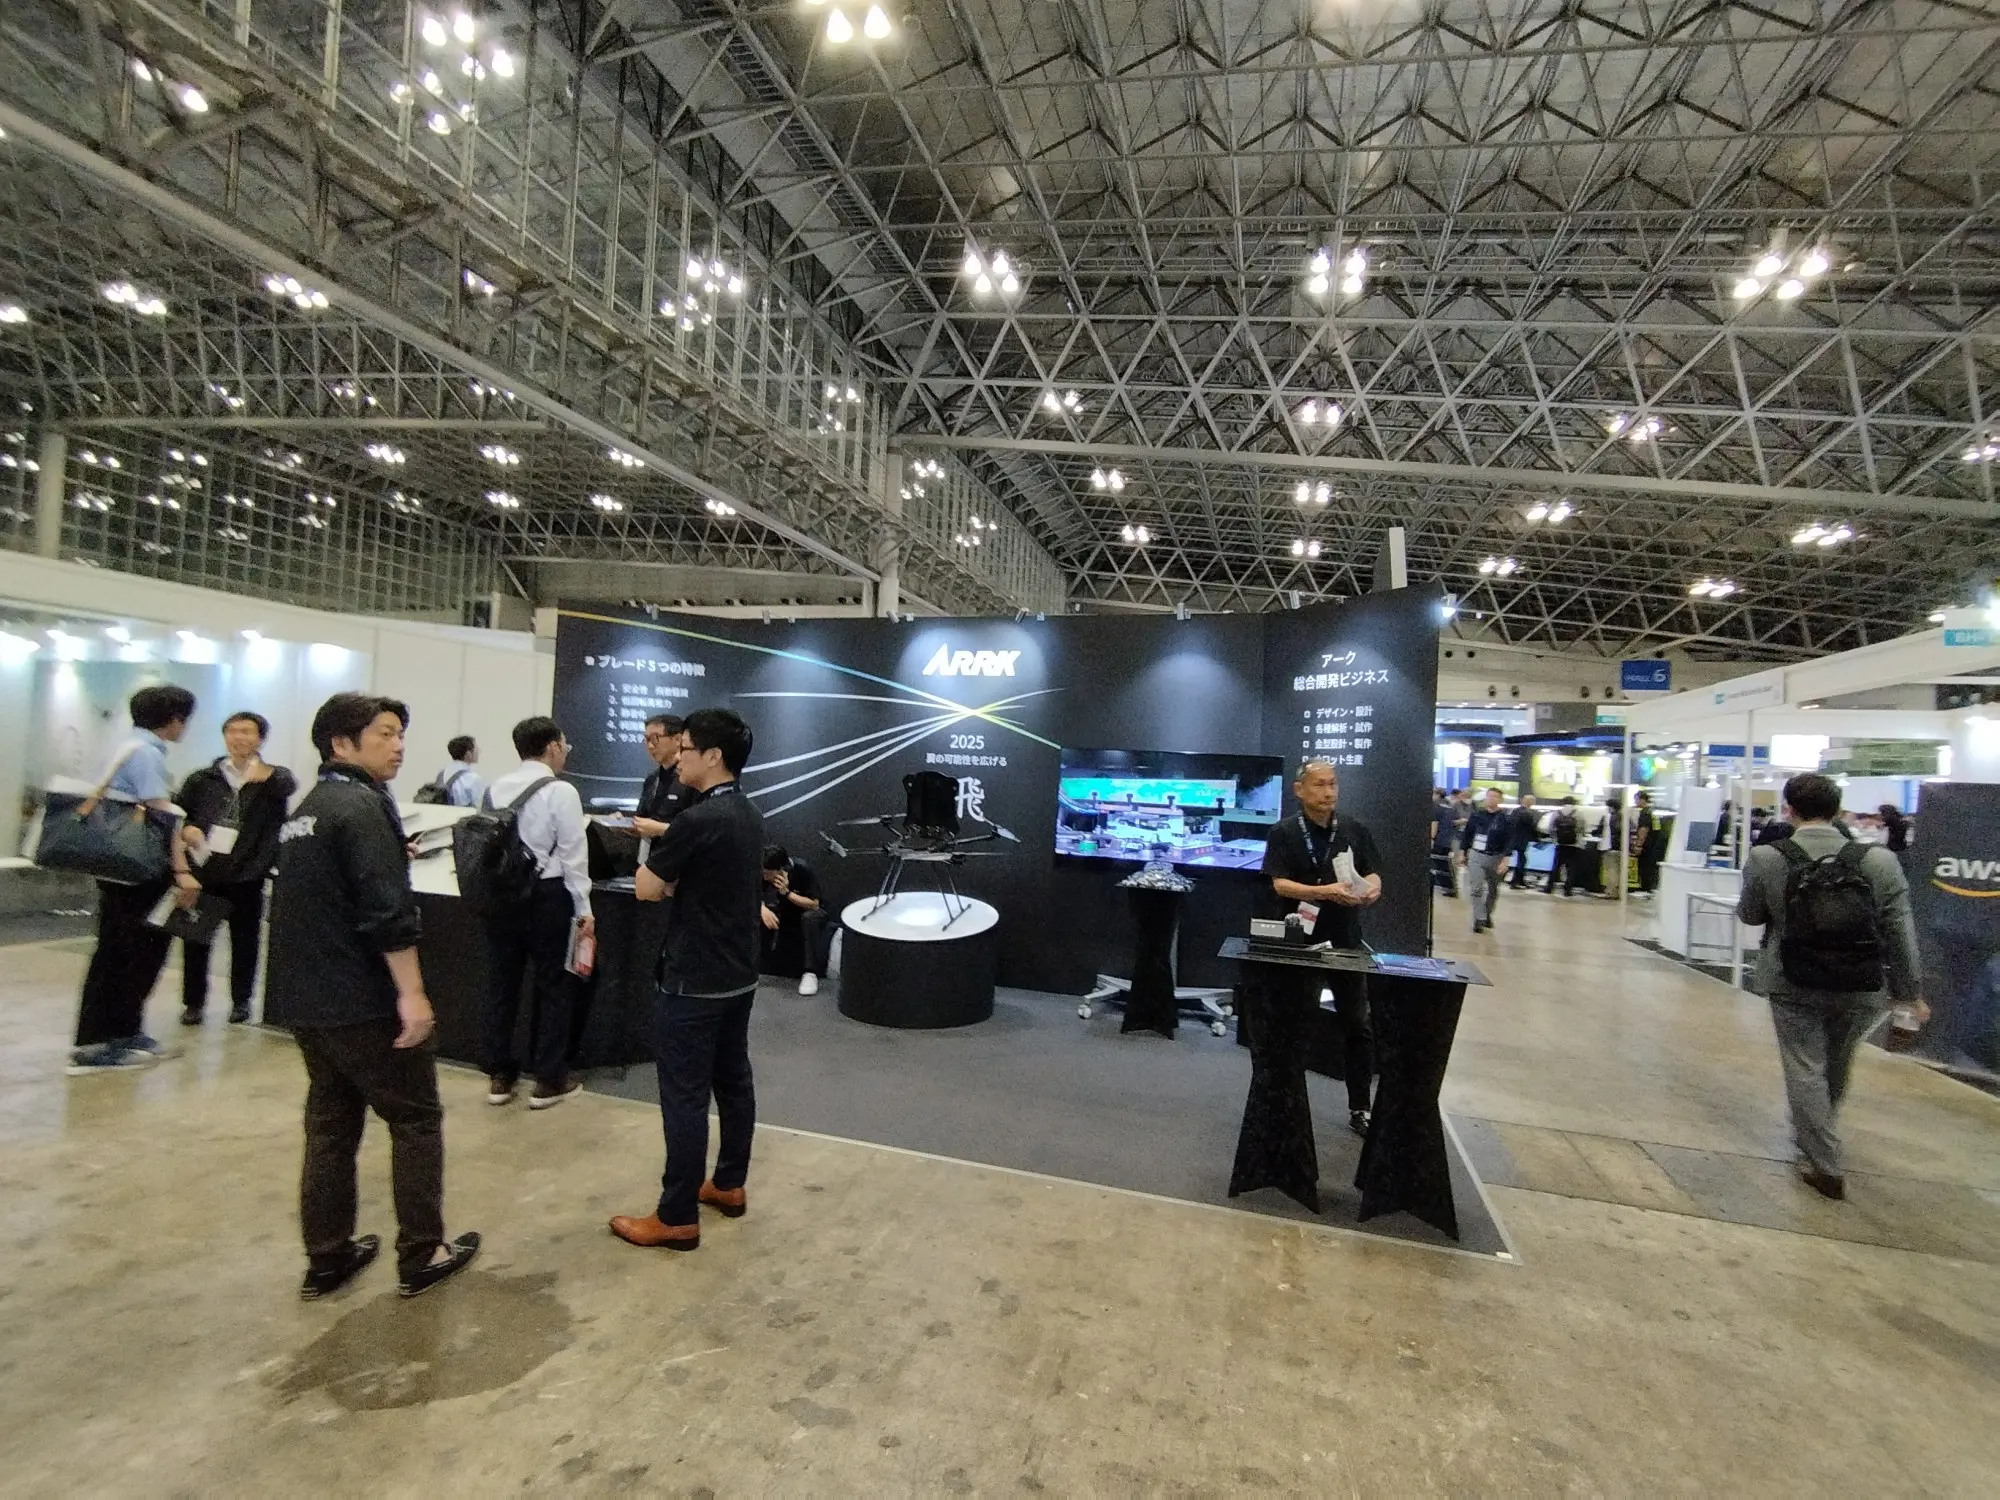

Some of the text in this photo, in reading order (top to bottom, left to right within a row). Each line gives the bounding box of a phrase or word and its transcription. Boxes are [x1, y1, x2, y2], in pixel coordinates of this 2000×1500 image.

[922, 643, 1021, 676] ARRK
[1321, 651, 1357, 668] アーク
[1293, 669, 1389, 691] 総合開発ビジネス
[1653, 669, 1667, 682] 6
[1316, 705, 1374, 719] デザイン・設計
[950, 735, 985, 750] 2025
